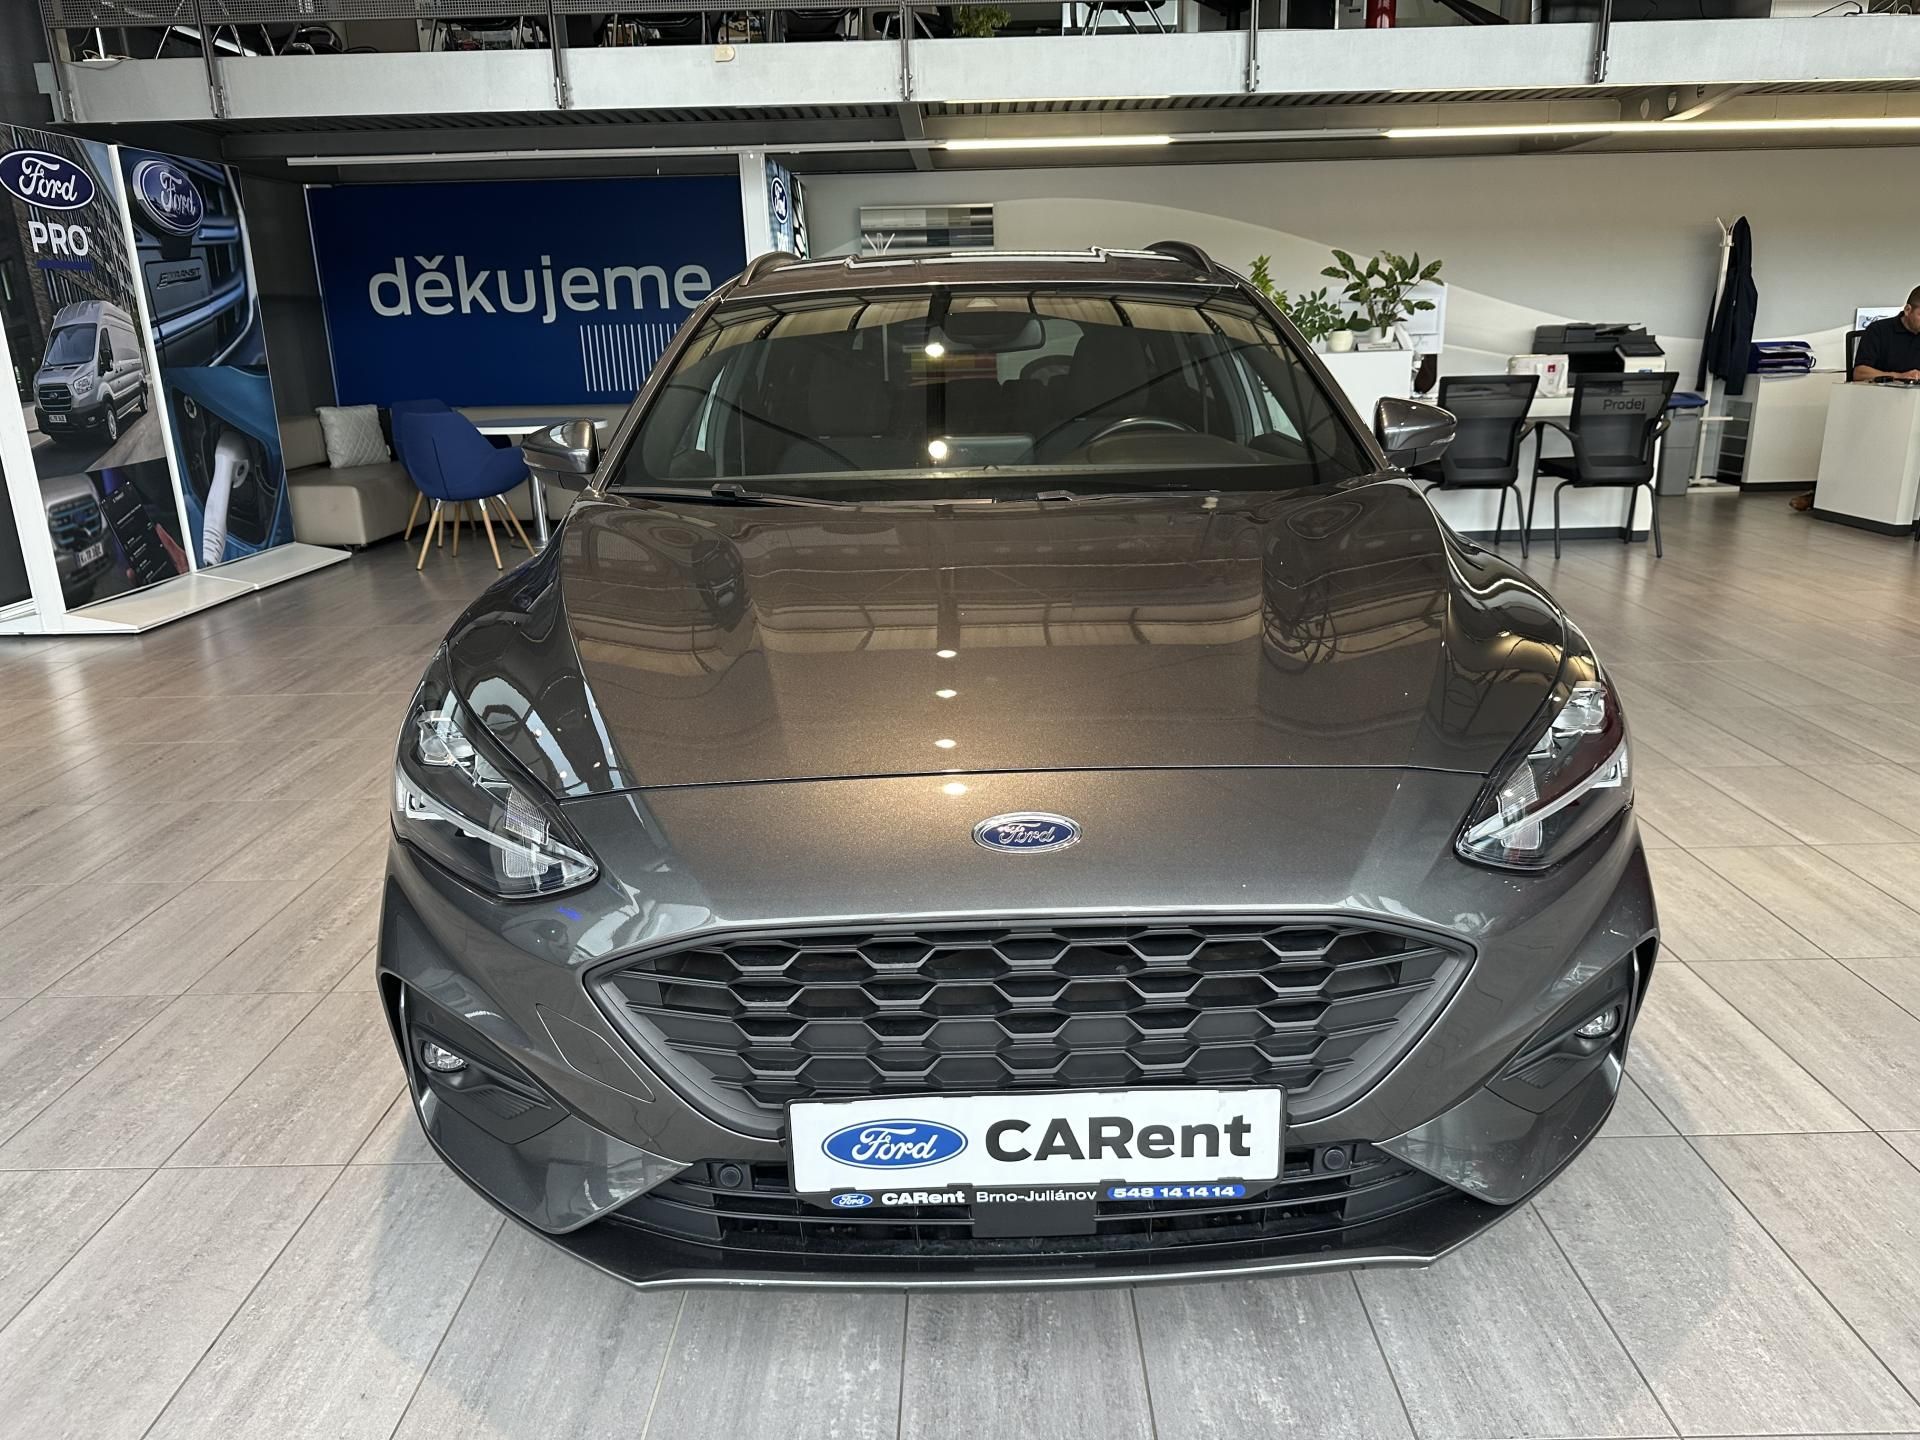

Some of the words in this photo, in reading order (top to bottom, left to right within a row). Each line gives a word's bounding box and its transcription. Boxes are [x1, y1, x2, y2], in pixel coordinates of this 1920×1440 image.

[19, 157, 77, 202] Ford
[160, 171, 196, 216] Ford
[368, 255, 712, 324] děkujeme
[1602, 398, 1646, 411] Prodej
[998, 822, 1056, 845] Ford
[851, 1127, 939, 1161] Ford
[985, 1114, 1252, 1163] CARent
[839, 1193, 866, 1206] Ford
[881, 1190, 966, 1206] CARent
[976, 1189, 1097, 1203] Brno-Juliánov
[1113, 1187, 1153, 1199] 548
[1160, 1187, 1182, 1198] 14
[1186, 1186, 1209, 1197] 14
[1212, 1186, 1236, 1197] 14
